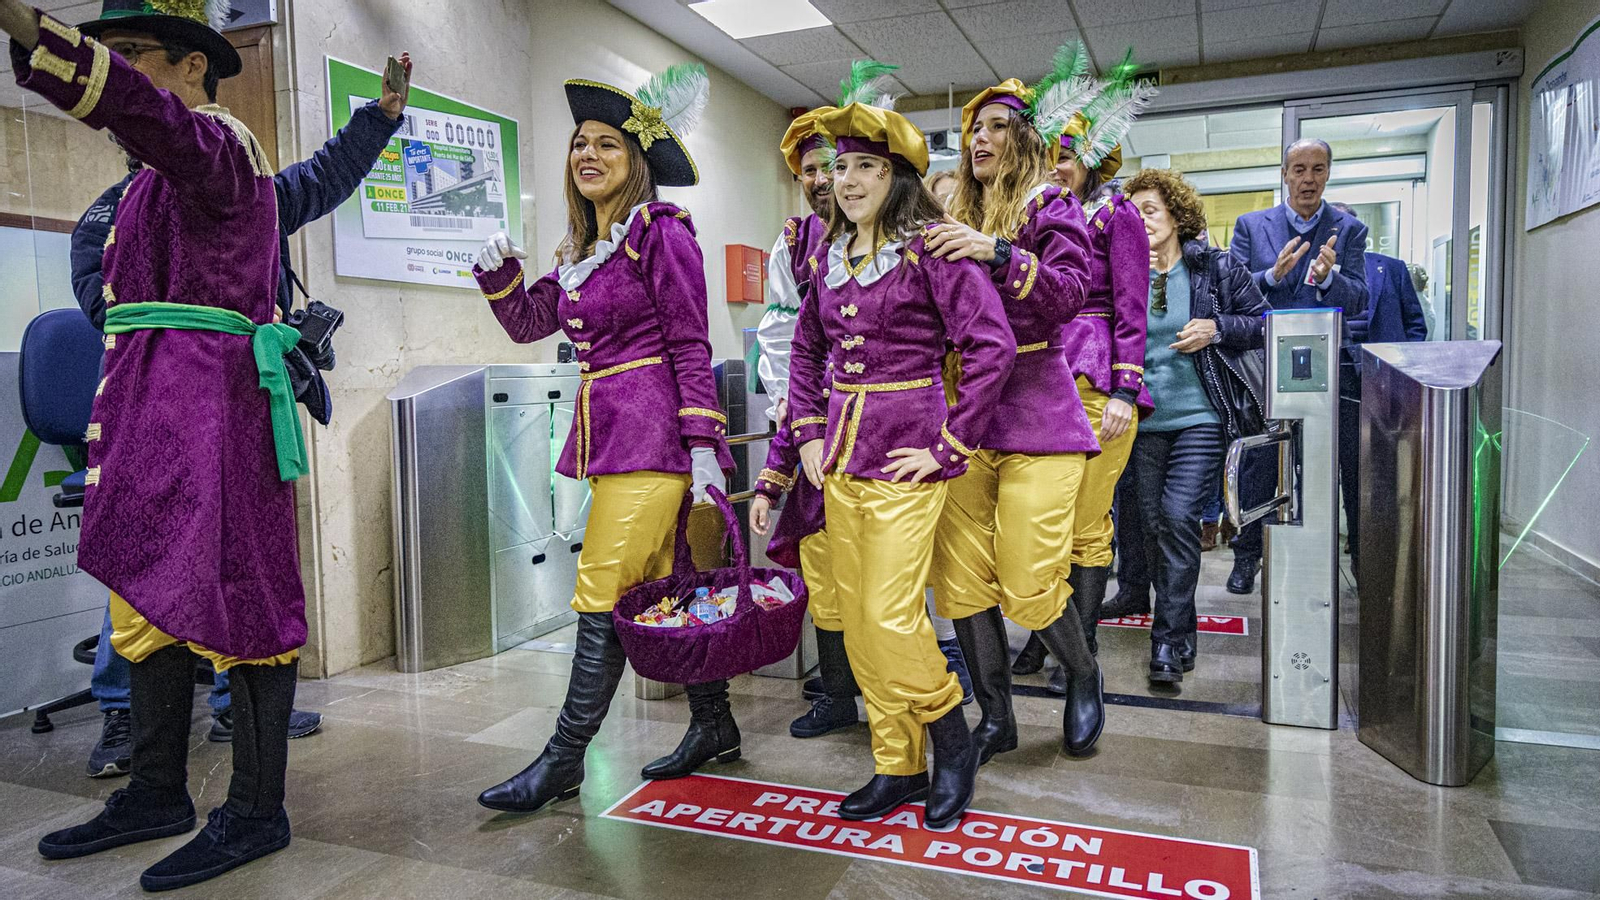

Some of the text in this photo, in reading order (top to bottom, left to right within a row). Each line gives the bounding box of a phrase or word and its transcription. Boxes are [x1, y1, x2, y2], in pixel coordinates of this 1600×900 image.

[426, 119, 438, 127] SERIE
[426, 130, 439, 141] 000
[377, 188, 404, 199] ONCE
[377, 202, 383, 211] 11
[400, 204, 407, 213] 21
[406, 247, 473, 263] grupo social ONCE
[12, 511, 80, 537] de An
[22, 547, 40, 561] de
[0, 573, 24, 587] CIO
[628, 800, 904, 854] APERTURA
[752, 791, 1103, 856] PREACIÓN
[923, 841, 1231, 900] PORTILLO
